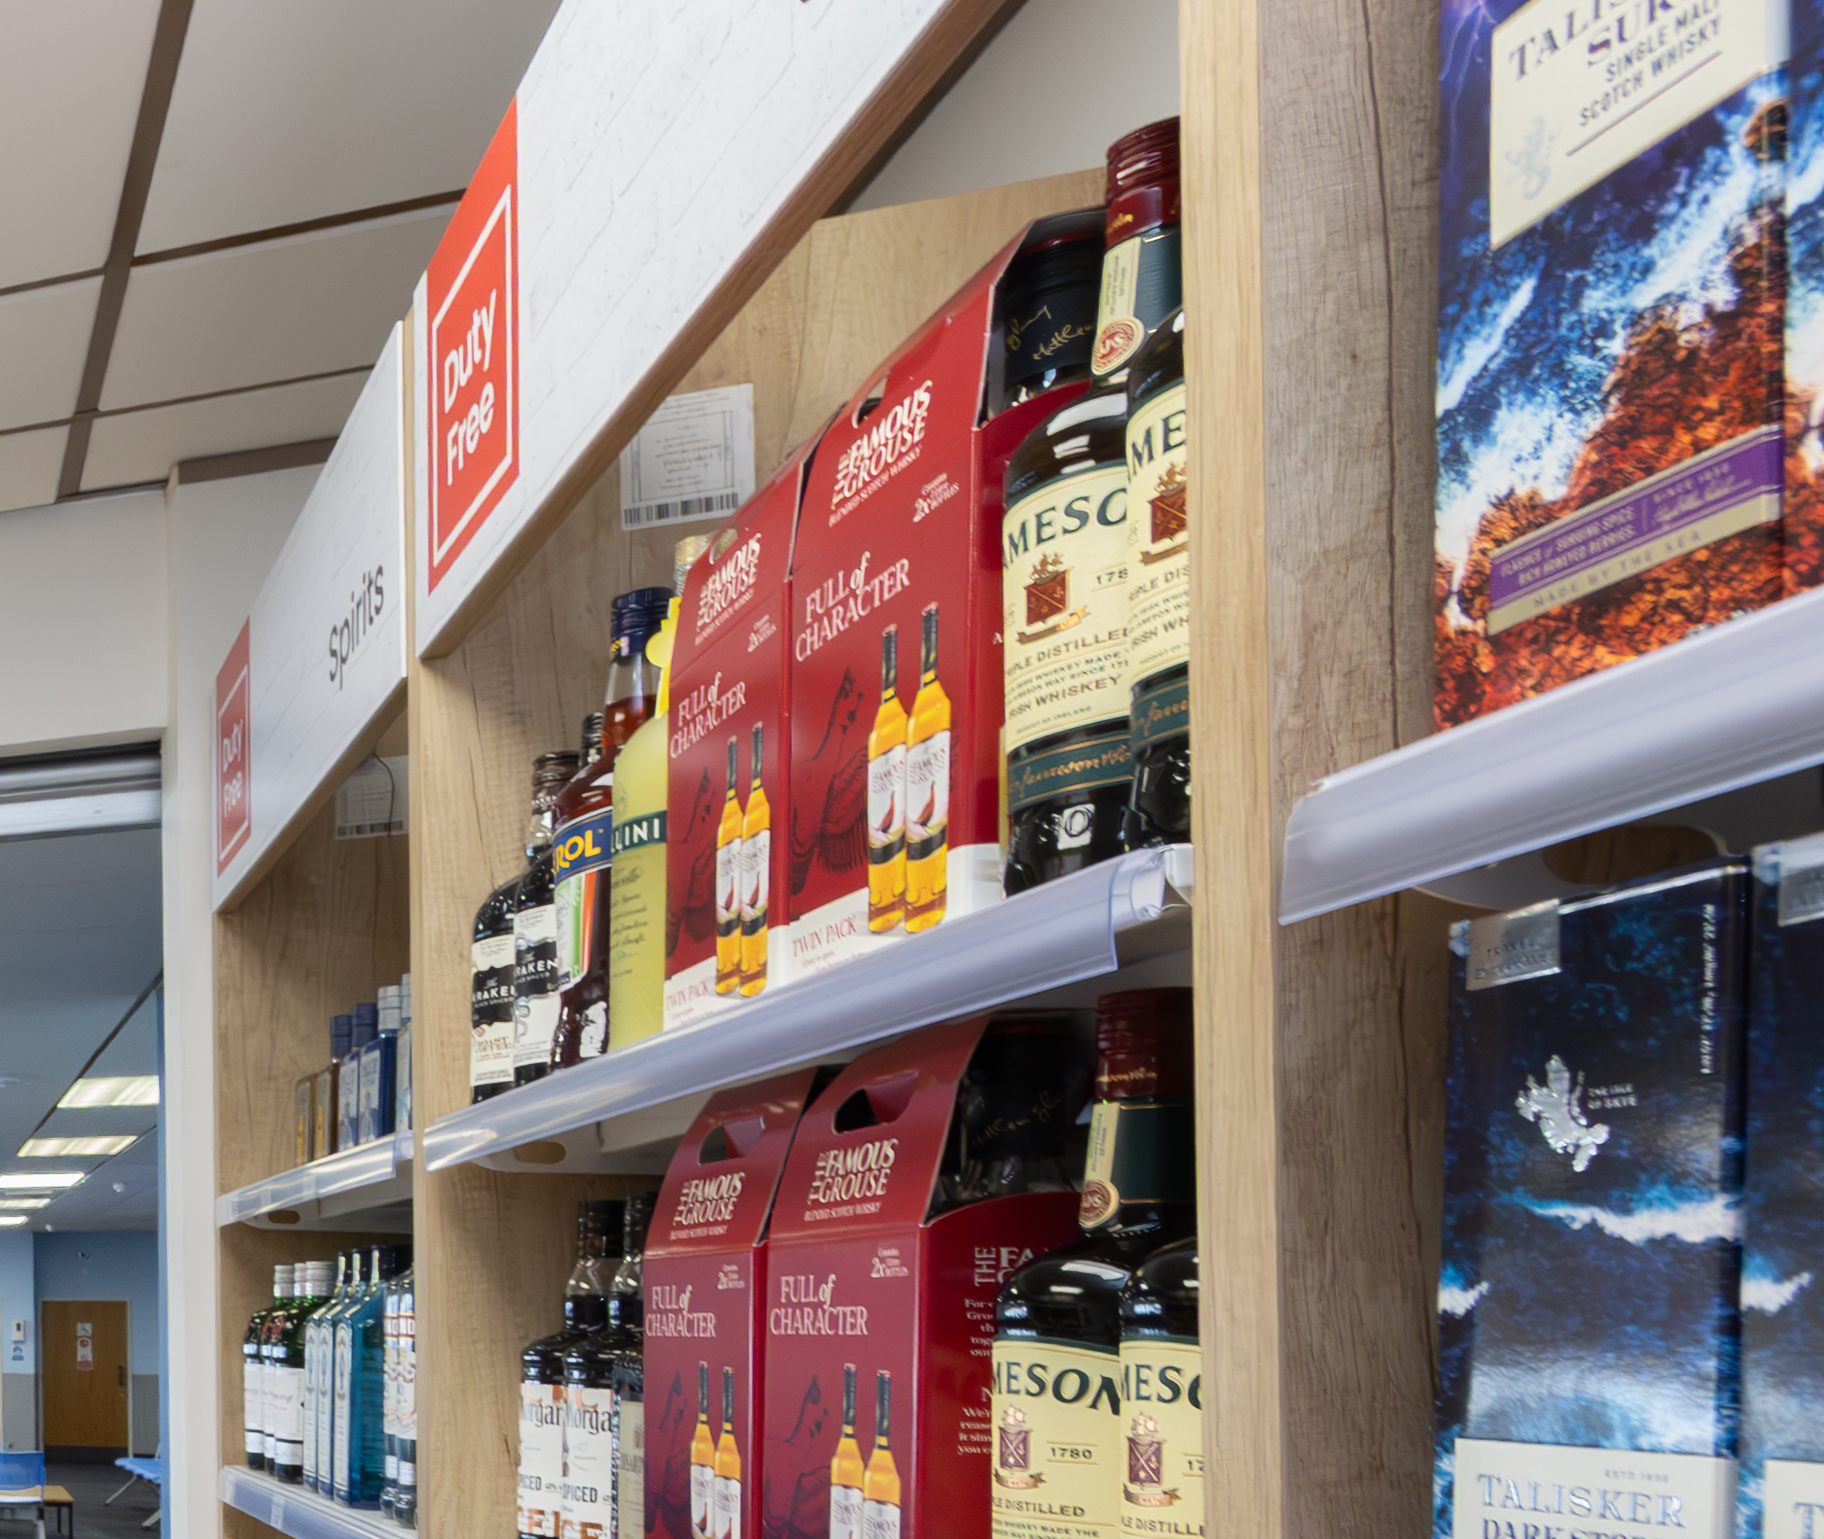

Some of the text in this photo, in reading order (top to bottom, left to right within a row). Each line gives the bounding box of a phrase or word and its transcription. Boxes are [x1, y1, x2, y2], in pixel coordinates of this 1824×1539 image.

[1579, 73, 1643, 126] SCOTCH
[1652, 18, 1721, 76] WHISKY
[443, 289, 496, 414] Duty
[447, 380, 495, 486] Free
[849, 380, 933, 466] FAMOUS
[844, 410, 926, 499] GROUSE
[704, 560, 757, 623] GROUSE
[707, 533, 761, 597] FAMOUS
[805, 551, 871, 624] FULL of
[795, 558, 910, 662] CHARACTER
[669, 681, 746, 758] CHARACTER
[678, 685, 707, 727] FULL
[222, 717, 243, 774] Duty
[826, 1138, 899, 1176] FAMOUS
[682, 1197, 737, 1226] GROUSE
[688, 1172, 746, 1203] FAMOUS
[818, 1168, 891, 1204] GROUSE
[652, 1284, 693, 1313] FULL of
[780, 1273, 837, 1308] FULL of
[646, 1312, 716, 1337] CHARACTER
[770, 1306, 868, 1336] CHARACTER
[1050, 1446, 1094, 1460] 1780
[1006, 1498, 1087, 1518] DISTILLED
[1476, 1473, 1686, 1529] TALISKER
